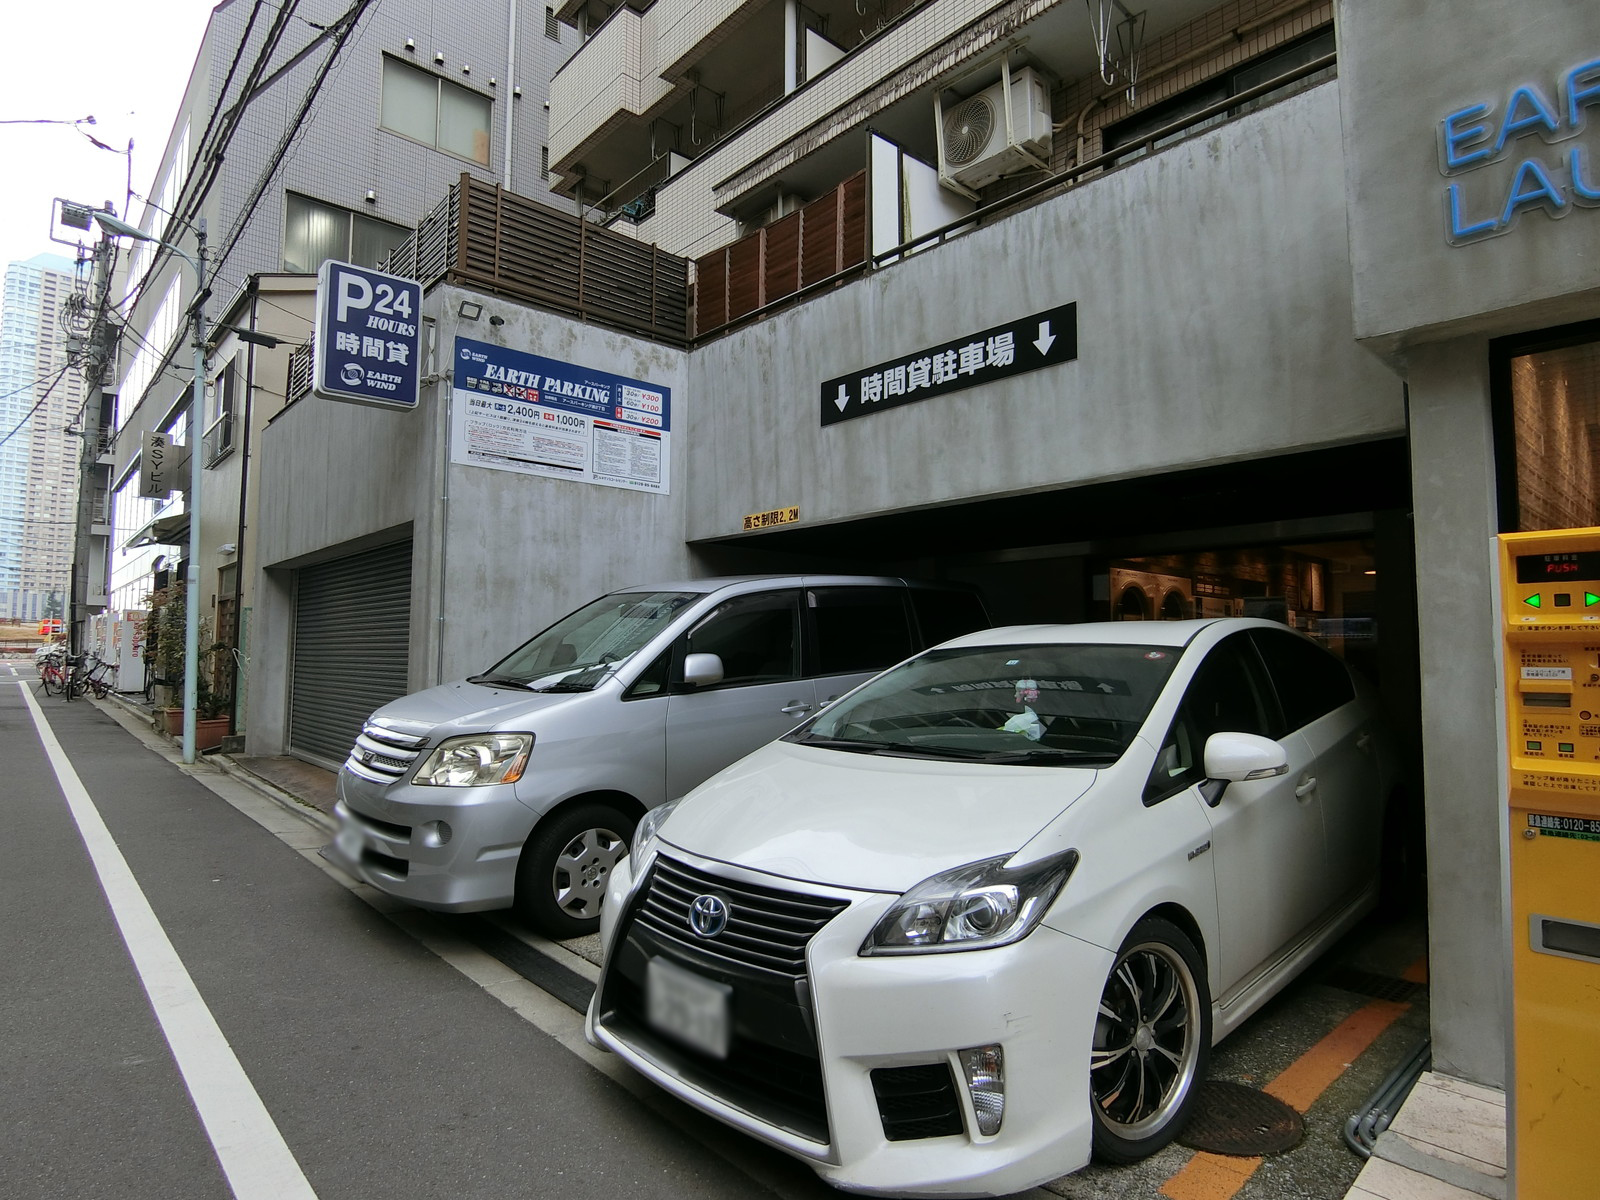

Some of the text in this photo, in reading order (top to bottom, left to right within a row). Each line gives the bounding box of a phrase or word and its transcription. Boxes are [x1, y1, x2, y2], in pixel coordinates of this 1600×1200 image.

[337, 271, 412, 323] P 24
[366, 315, 417, 338] HOURS
[336, 331, 410, 366] 時間貸
[471, 352, 488, 360] EARTH
[860, 331, 1015, 405] 時間貸駐車場
[366, 370, 402, 384] EARTH
[484, 363, 611, 404] EARTH PARKING
[366, 379, 397, 391] WIND
[584, 379, 611, 390] アースパーキング
[641, 392, 660, 403] ¥300
[469, 398, 493, 410] 当日最大
[507, 404, 540, 420] 2,400円
[556, 415, 585, 429] 1,000円
[641, 402, 660, 413] ¥100
[641, 415, 660, 426] ¥200
[743, 508, 799, 530] 高さ制限2.2M
[1546, 563, 1578, 573] PUSH
[1523, 780, 1600, 791] 確認した上で出庫して下
